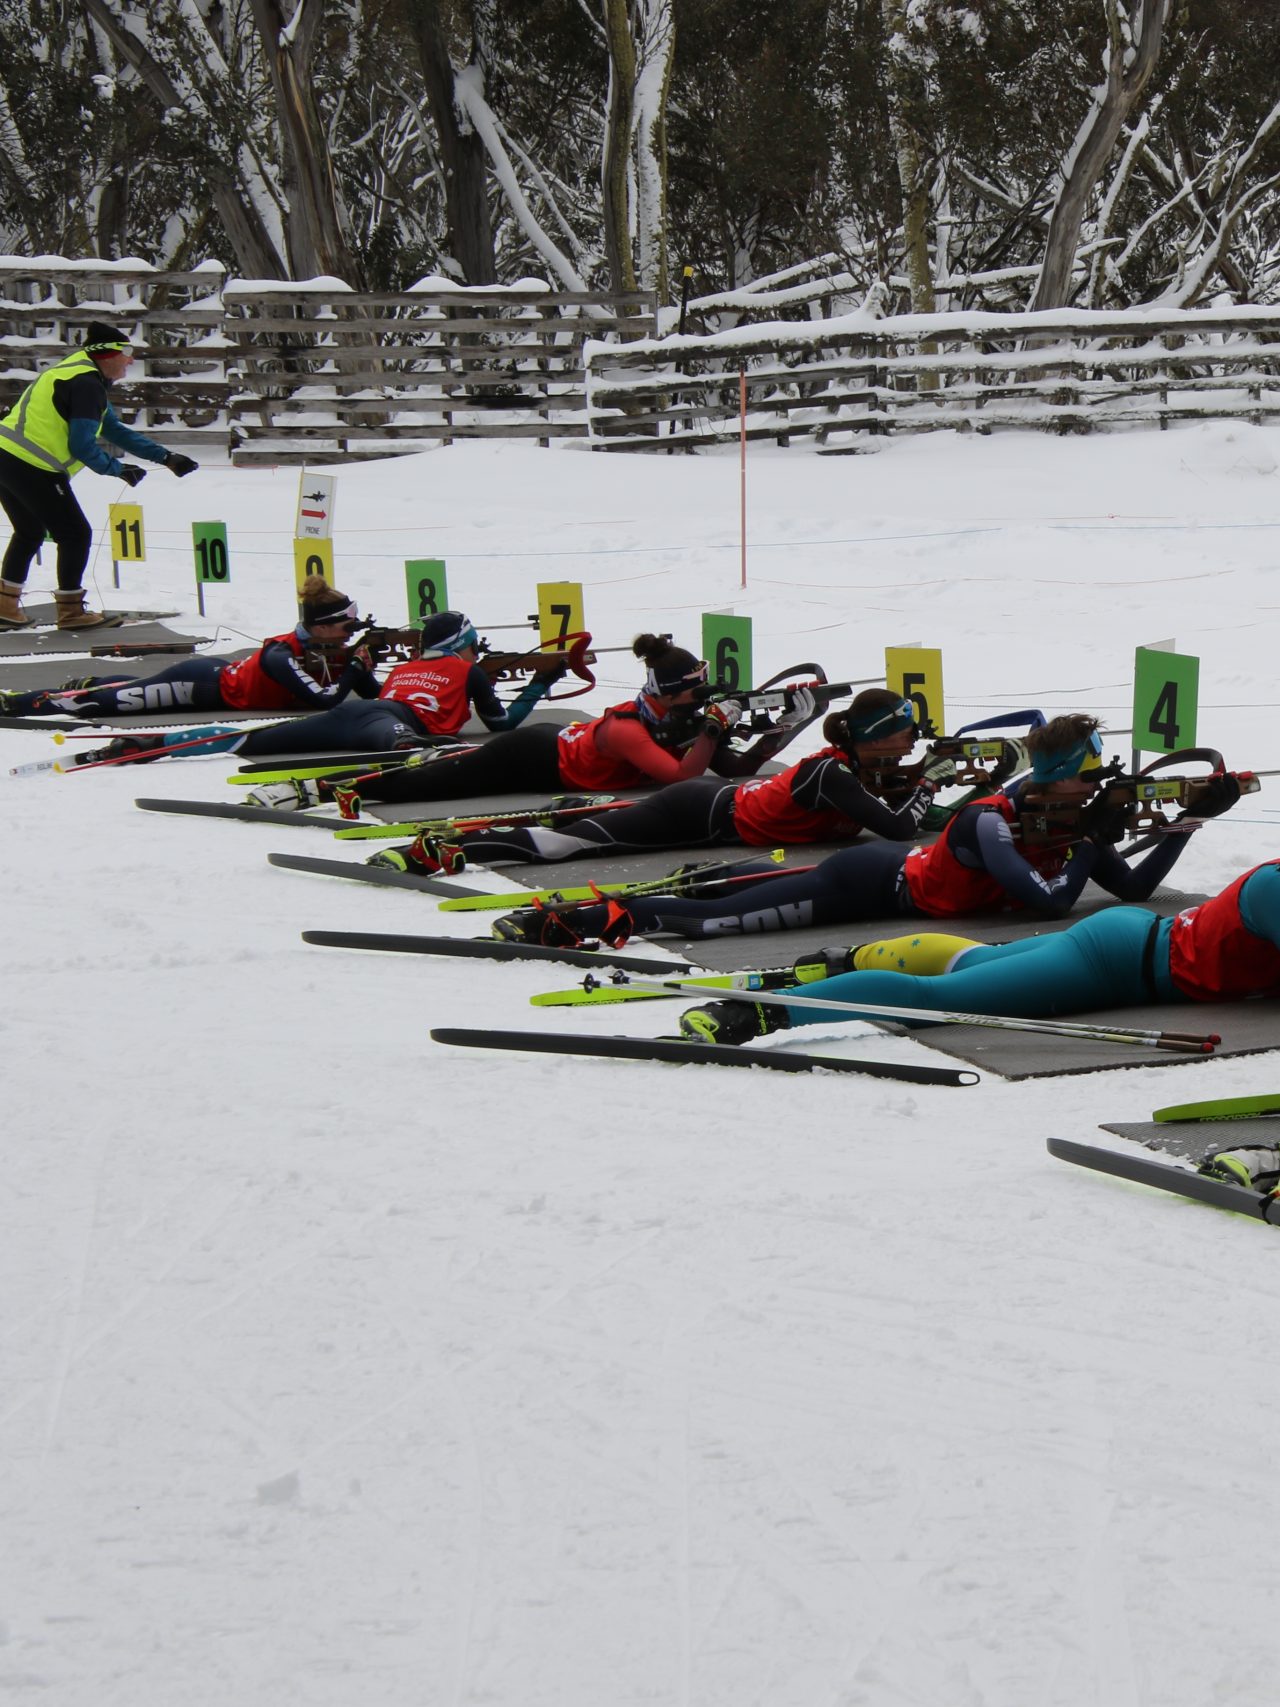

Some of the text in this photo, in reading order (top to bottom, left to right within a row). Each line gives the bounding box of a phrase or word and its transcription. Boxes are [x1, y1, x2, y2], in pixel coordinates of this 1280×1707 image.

[115, 519, 142, 557] 11
[196, 538, 228, 580] 10
[550, 604, 571, 652] 7
[716, 637, 739, 690] 6
[116, 681, 195, 712] AUS
[903, 673, 929, 730] 5
[1149, 681, 1180, 749] 4
[910, 792, 932, 827] AUS
